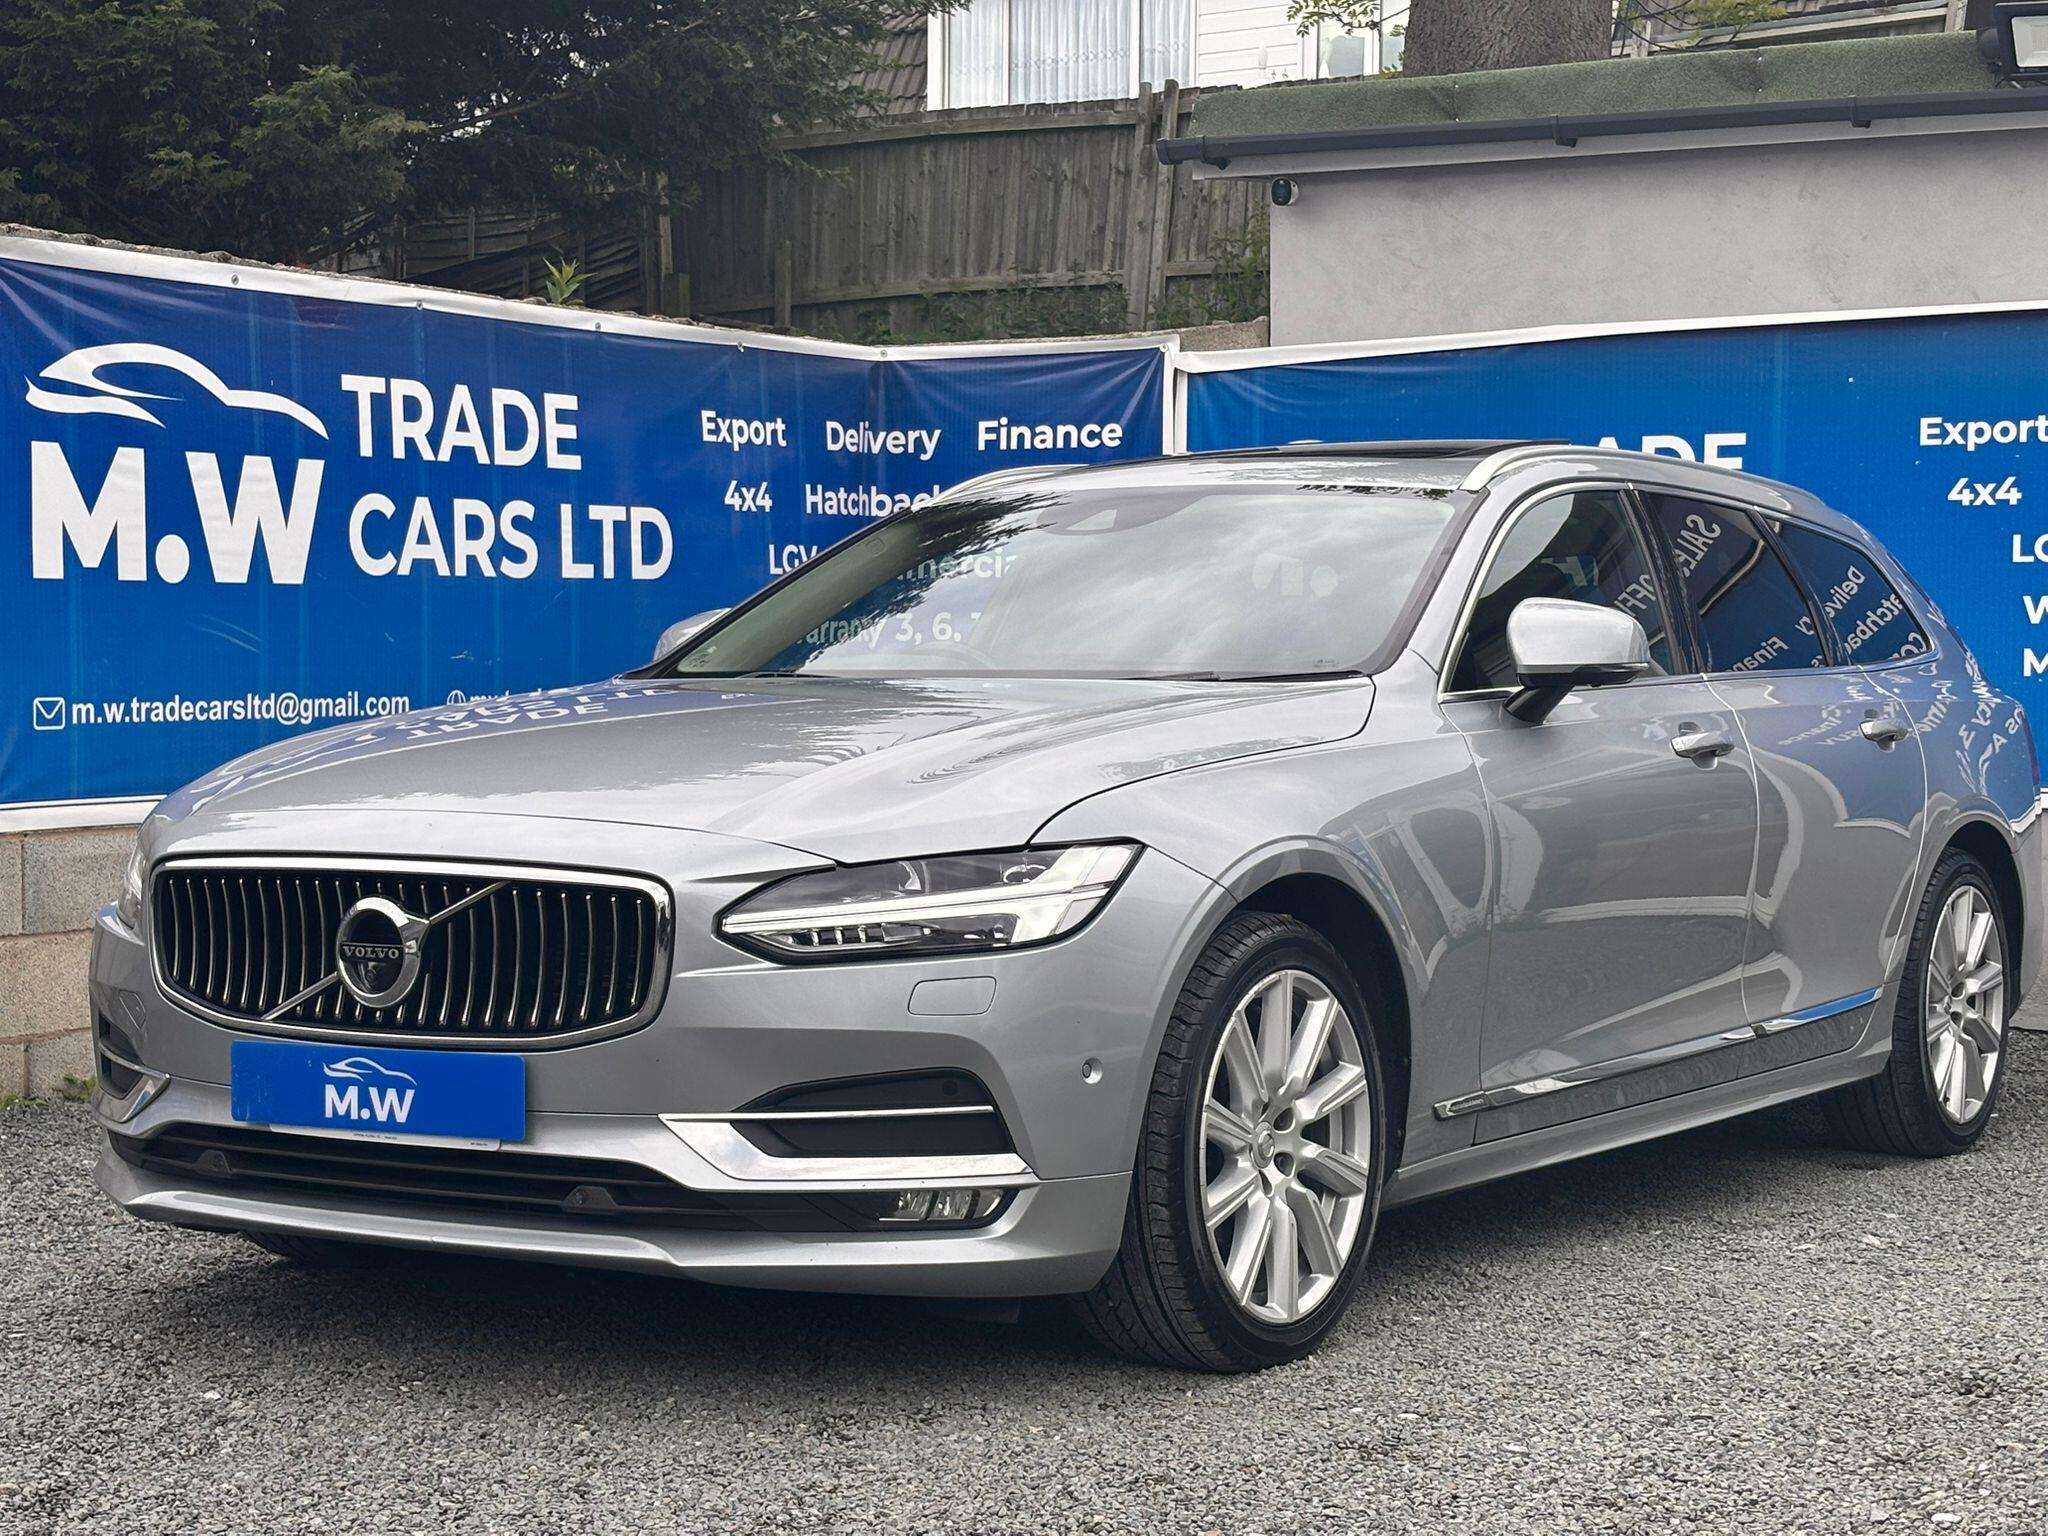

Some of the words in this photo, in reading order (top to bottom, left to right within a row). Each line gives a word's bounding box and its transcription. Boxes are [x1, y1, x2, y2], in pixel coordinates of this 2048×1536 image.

[341, 374, 582, 470] TRADE
[701, 410, 787, 452] Export
[826, 420, 941, 461] Delivery
[977, 417, 1123, 451] Finance
[1919, 414, 2048, 452] Export
[724, 480, 773, 513] 4x4
[1947, 476, 2023, 506] 4x4
[31, 441, 325, 584] M.W
[349, 493, 536, 578] CARS
[561, 503, 673, 581] LTD
[71, 691, 410, 726] m.w.tradecarsltd@gmail.com
[342, 945, 400, 959] VOLVO
[324, 1083, 416, 1124] M.W
